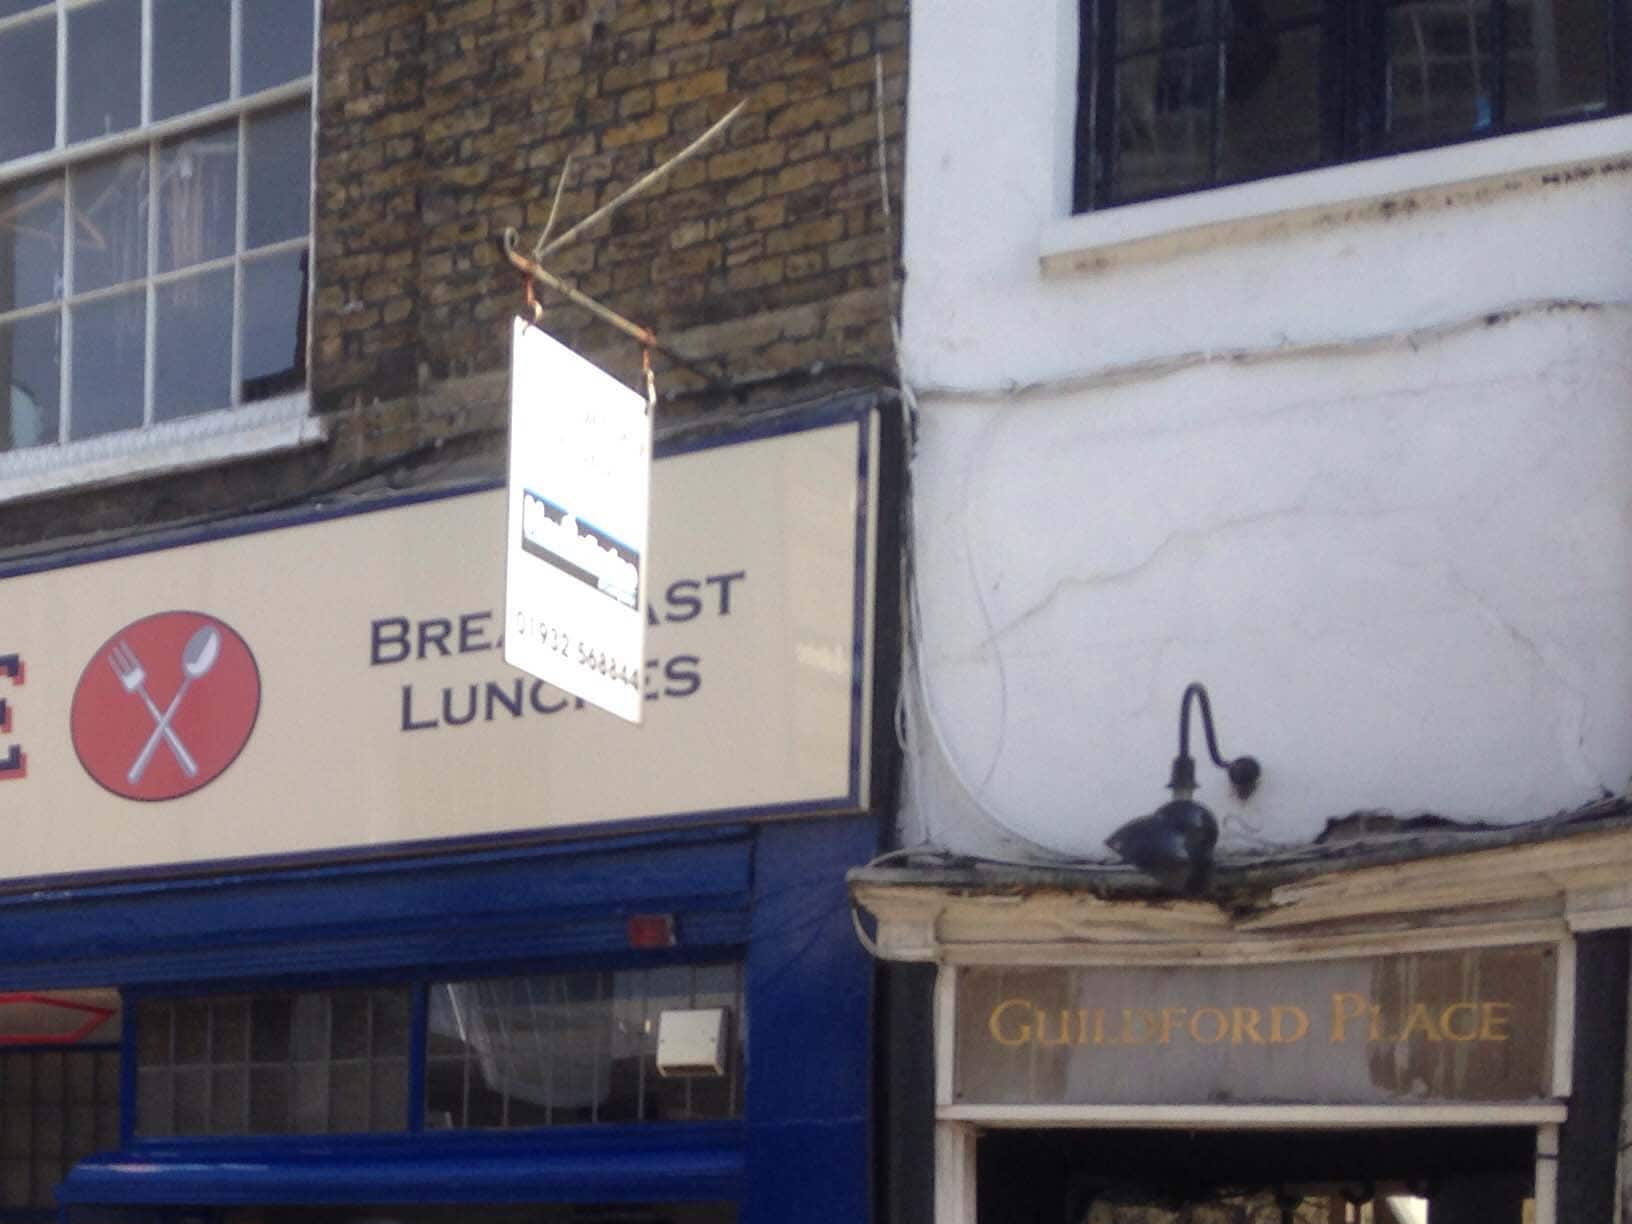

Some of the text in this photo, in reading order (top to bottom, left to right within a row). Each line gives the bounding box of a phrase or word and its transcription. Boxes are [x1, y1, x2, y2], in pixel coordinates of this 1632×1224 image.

[369, 570, 747, 666] BREST
[400, 654, 703, 732] LUNCES
[988, 992, 1512, 1045] GUILDFORD PLACE
